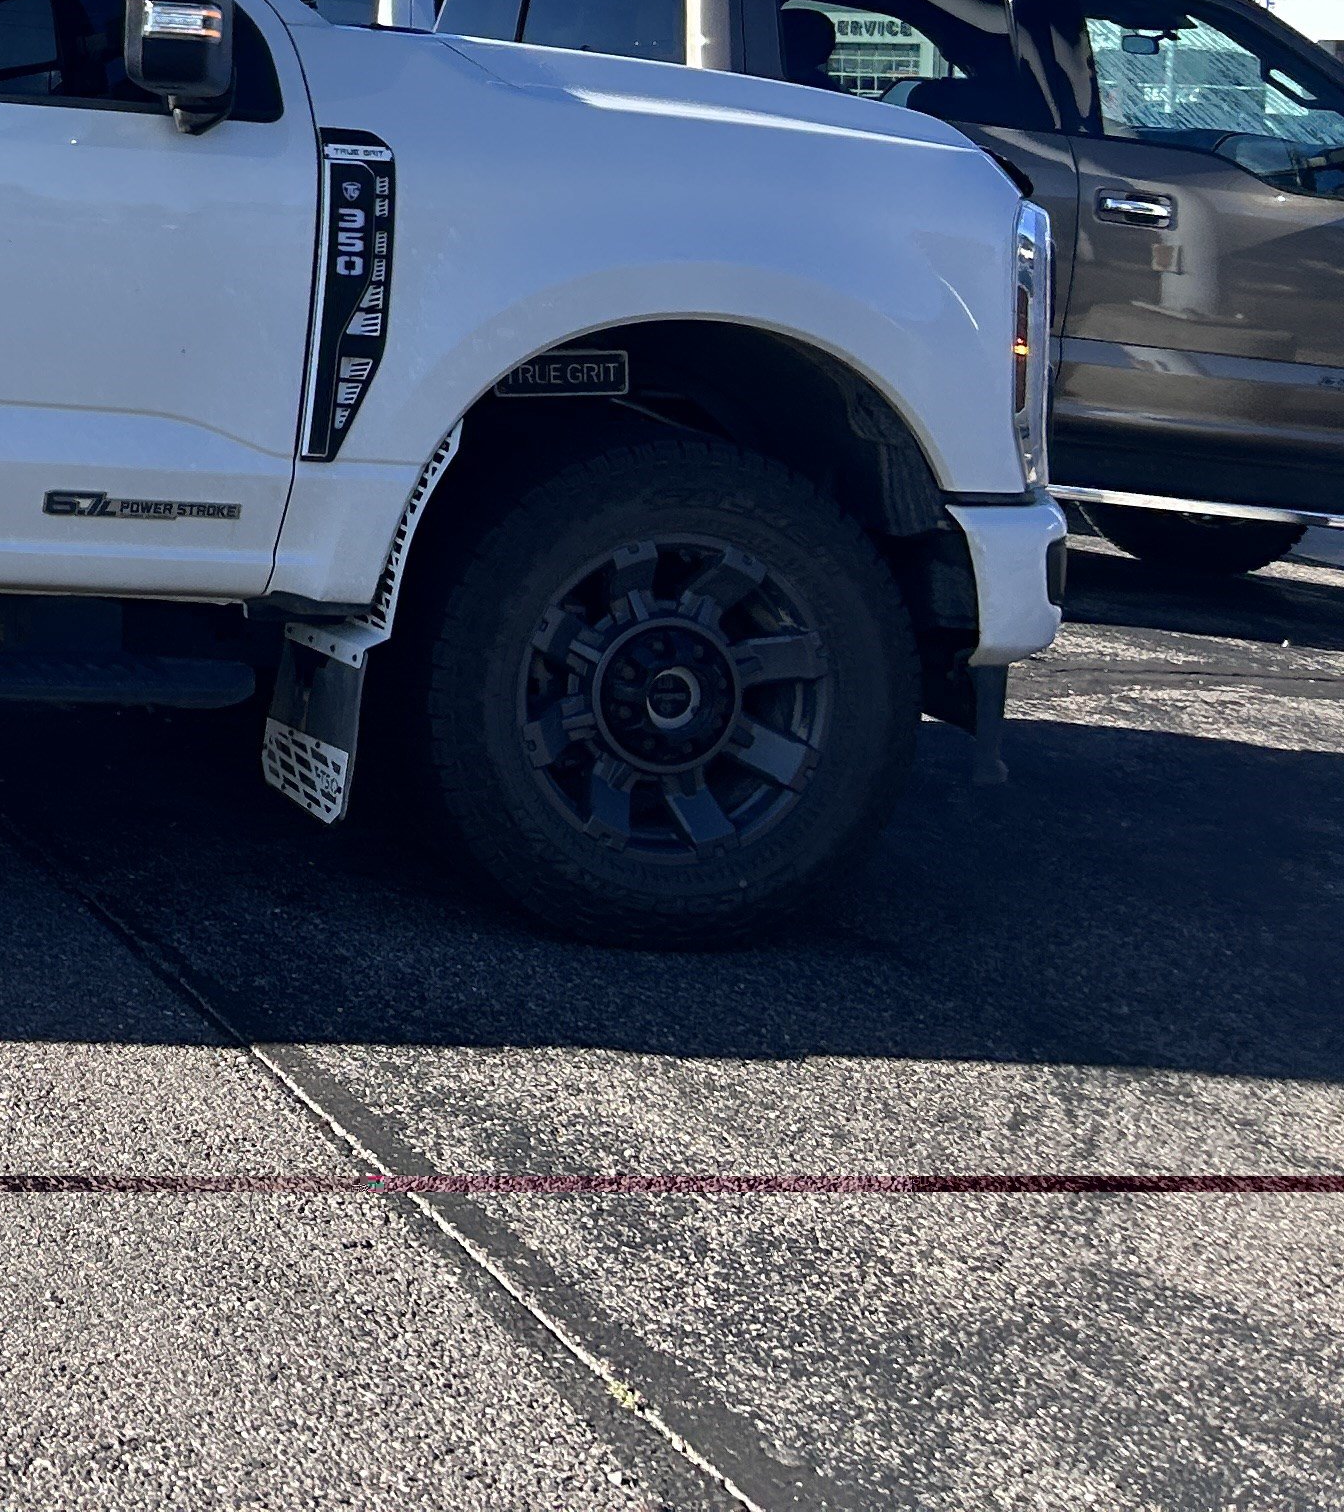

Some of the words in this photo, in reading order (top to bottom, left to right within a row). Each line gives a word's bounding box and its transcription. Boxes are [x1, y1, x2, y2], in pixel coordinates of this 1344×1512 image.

[837, 20, 913, 37] ERVICE
[333, 148, 360, 156] TRUE
[363, 149, 384, 158] GRIT
[336, 208, 365, 276] 350
[566, 363, 619, 384] GRIT
[42, 489, 117, 517] 6.7L
[119, 500, 174, 516] POWER
[176, 503, 238, 518] STROKE
